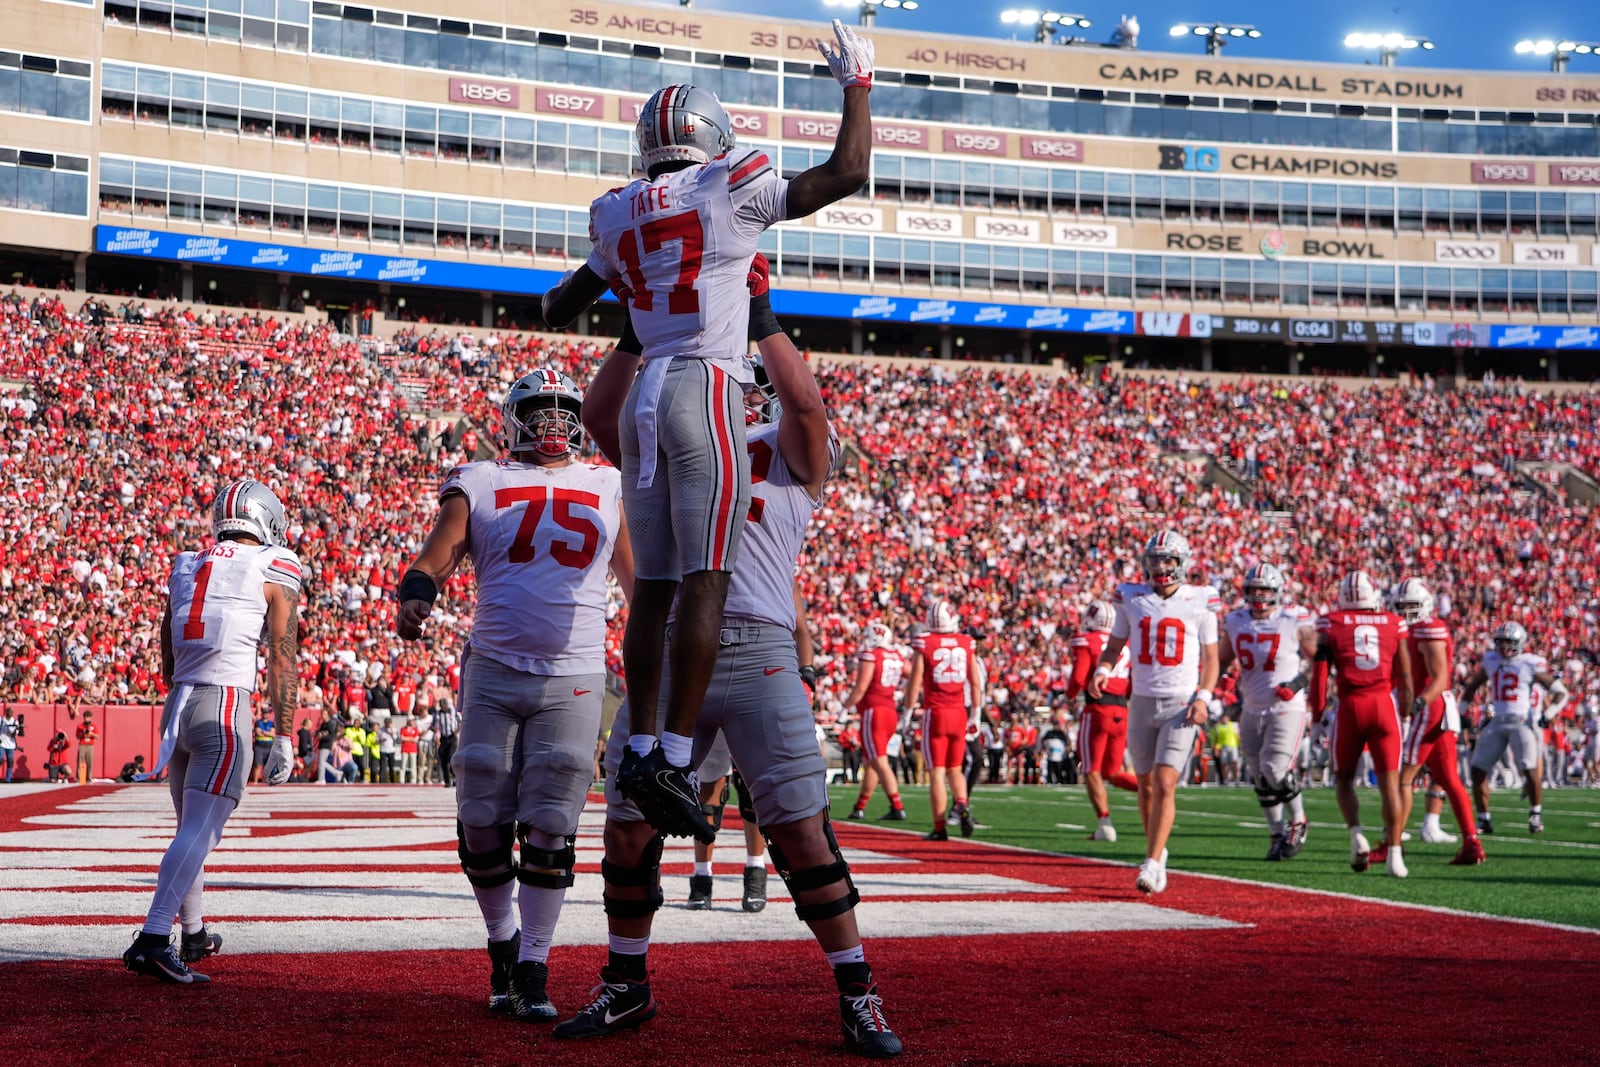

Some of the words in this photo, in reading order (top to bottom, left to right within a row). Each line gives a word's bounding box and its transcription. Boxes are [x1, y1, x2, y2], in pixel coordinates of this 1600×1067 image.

[570, 9, 598, 25] 35
[606, 15, 702, 39] AMECHE
[751, 32, 777, 48] 33
[907, 49, 937, 63] 40
[945, 50, 1026, 72] HIRSCH
[1099, 64, 1179, 83] CAMP
[1196, 70, 1327, 91] RANDALL
[1341, 78, 1463, 98] STADIUM
[460, 83, 512, 102] 1896
[547, 93, 595, 111] 1897
[797, 121, 838, 136] 1912
[876, 127, 921, 143] 1952
[954, 134, 999, 150] 1959
[1031, 141, 1076, 157] 1962
[1232, 154, 1398, 178] CHAMPIONS
[630, 185, 670, 220] TATE
[825, 211, 874, 226] 1960
[907, 217, 952, 231] 1963
[116, 230, 150, 242] Siding
[985, 222, 1030, 237] 1994
[1062, 228, 1108, 242] 1999
[107, 237, 159, 252] Unlimited
[186, 238, 220, 249] Siding
[1167, 233, 1243, 251] ROSE
[1303, 239, 1384, 258] BOWL
[177, 245, 228, 259] Unlimited
[320, 252, 354, 263] Siding
[1440, 246, 1495, 258] 2000
[1526, 248, 1565, 260] 2011
[311, 259, 362, 274] Unlimited
[386, 260, 418, 270] Siding
[617, 209, 704, 315] 17
[378, 266, 427, 280] Unlimited
[1270, 320, 1280, 334] 4
[1295, 321, 1330, 337] 0:04
[1418, 328, 1431, 339] 10
[494, 486, 600, 569] 75
[183, 561, 213, 640] 1
[1138, 616, 1186, 667] 10
[1353, 624, 1380, 671] 9
[1236, 633, 1281, 672] 67
[933, 647, 967, 684] 29
[1492, 671, 1519, 702] 12
